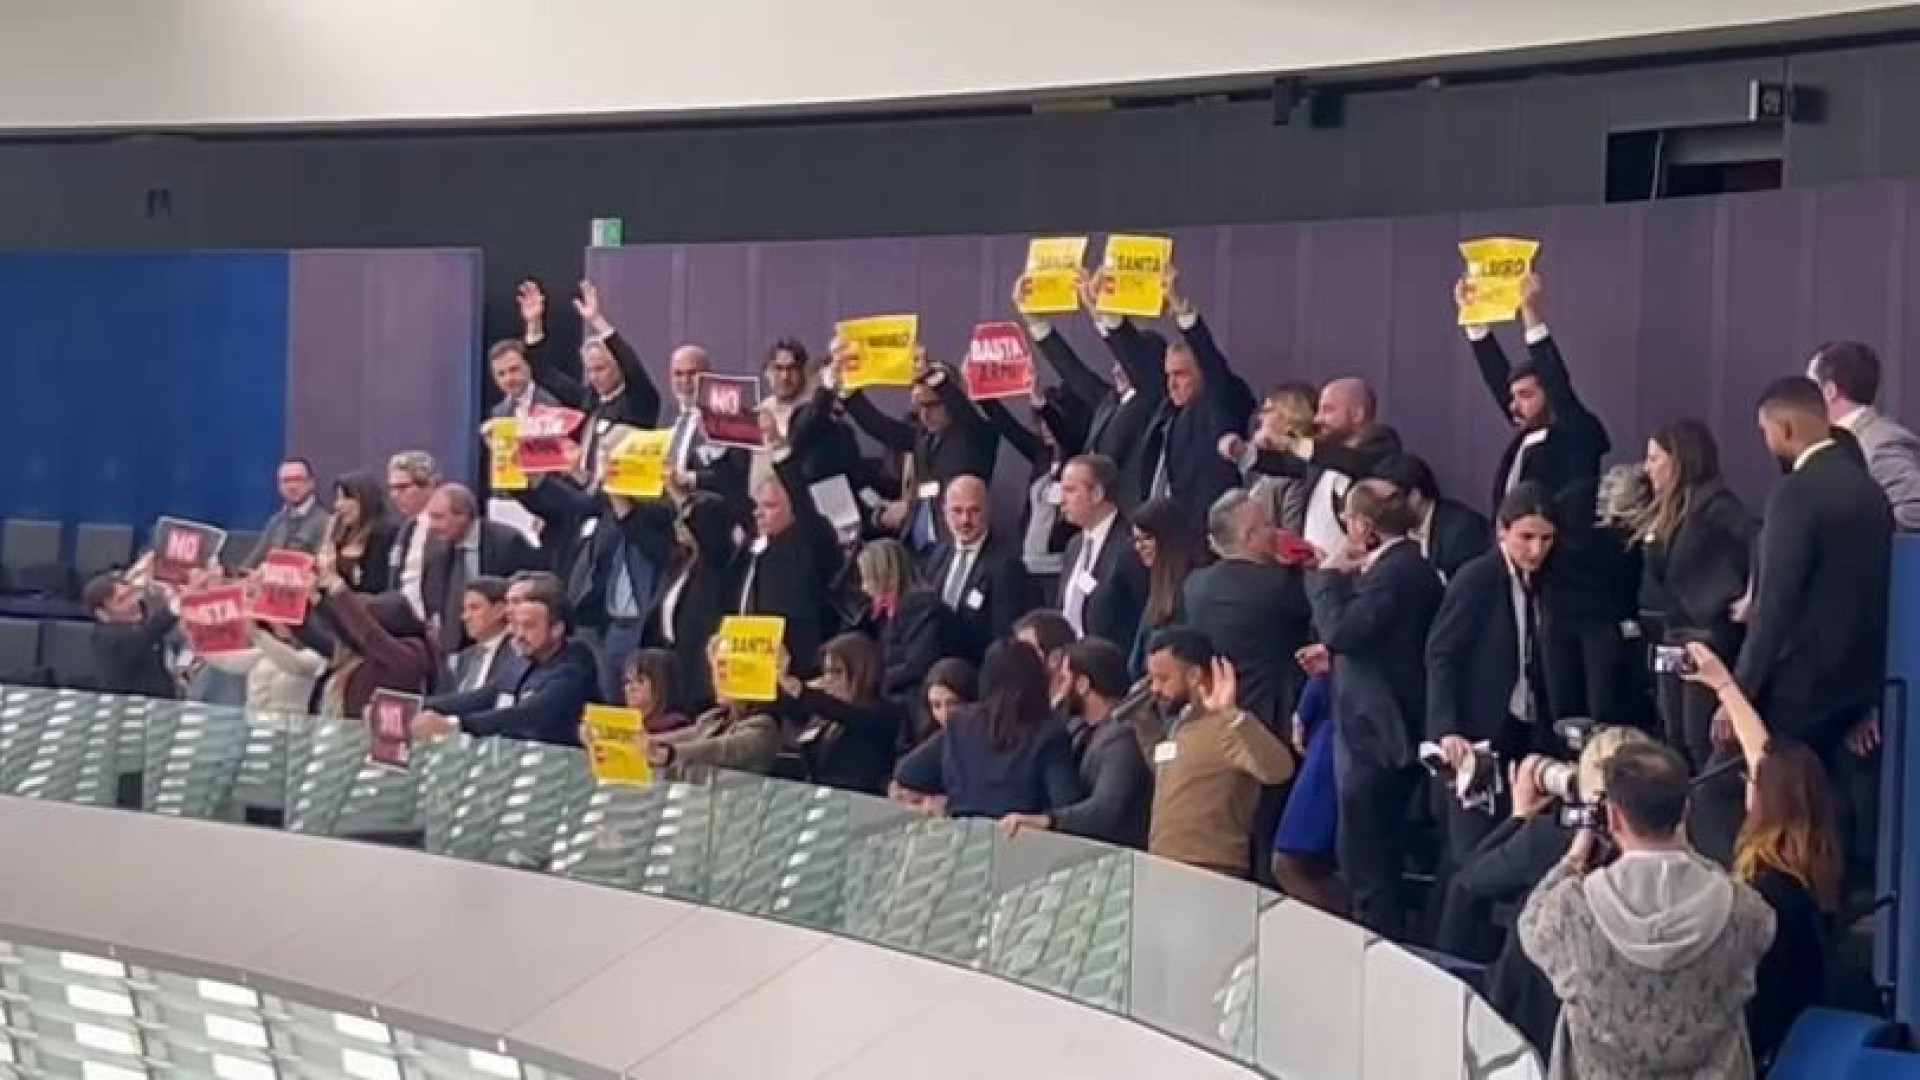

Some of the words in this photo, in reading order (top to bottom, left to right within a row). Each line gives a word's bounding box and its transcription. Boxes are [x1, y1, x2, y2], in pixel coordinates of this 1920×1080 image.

[971, 336, 1023, 361] BASTA
[709, 385, 740, 415] NO
[166, 528, 201, 562] NO
[379, 703, 404, 736] NO
